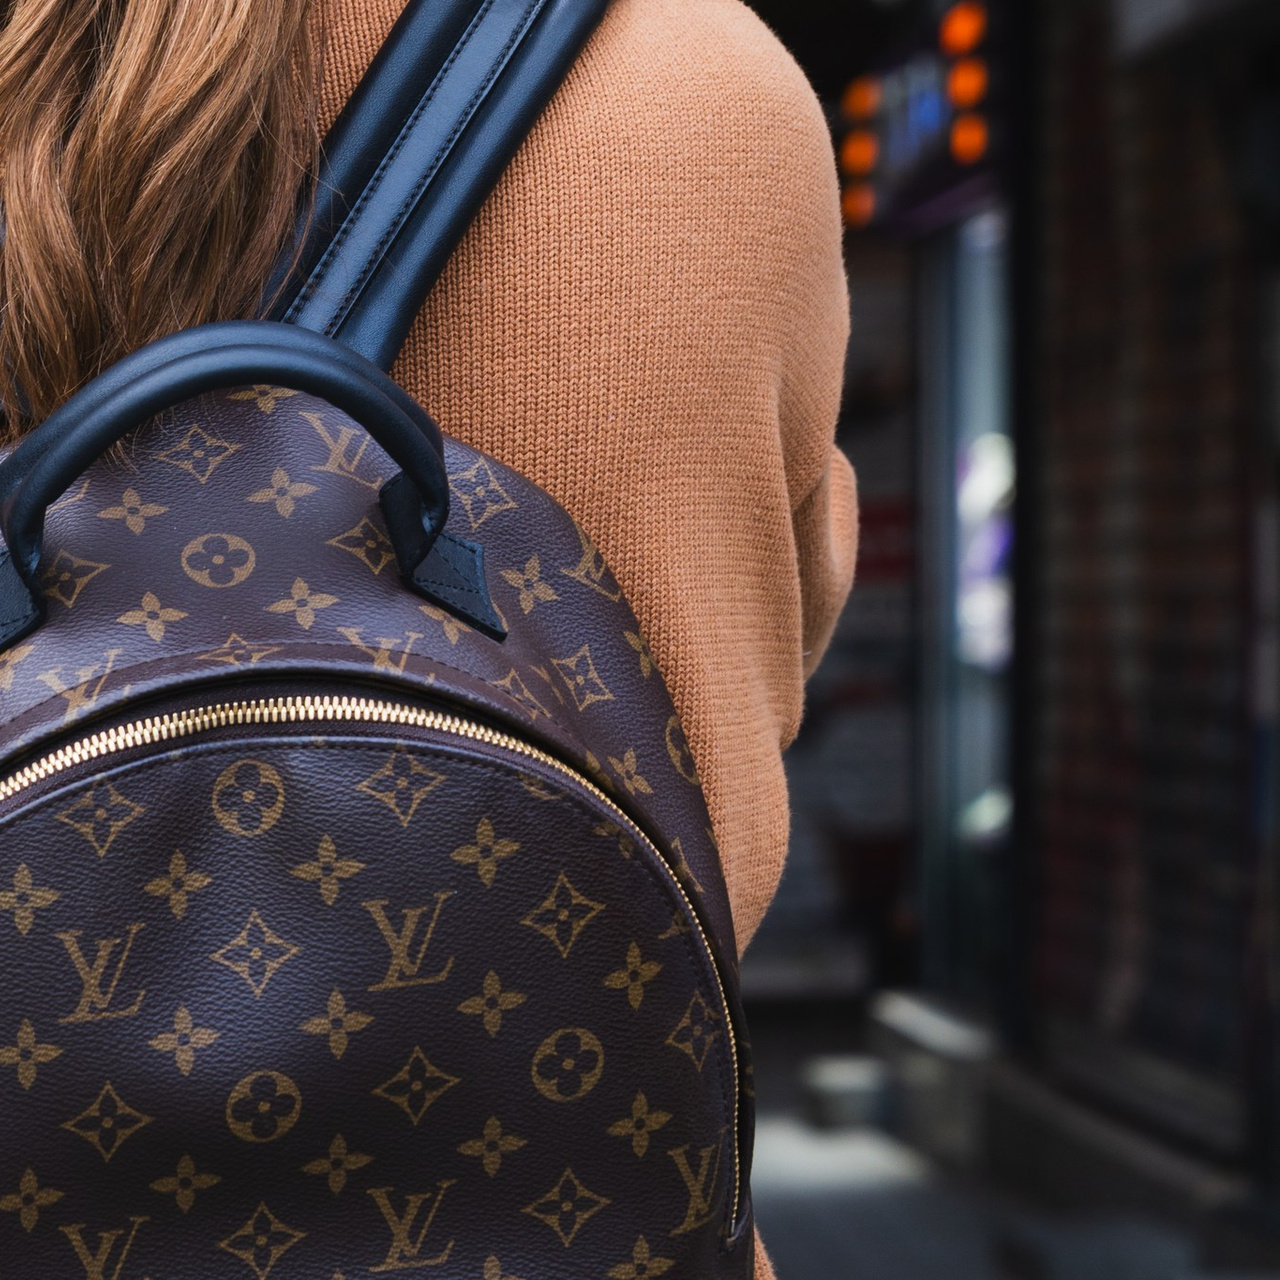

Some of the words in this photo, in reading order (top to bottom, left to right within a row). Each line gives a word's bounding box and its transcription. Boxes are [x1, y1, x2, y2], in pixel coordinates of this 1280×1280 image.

[55, 922, 147, 1024] LV
[361, 891, 454, 992] LV
[366, 1178, 458, 1274] LV
